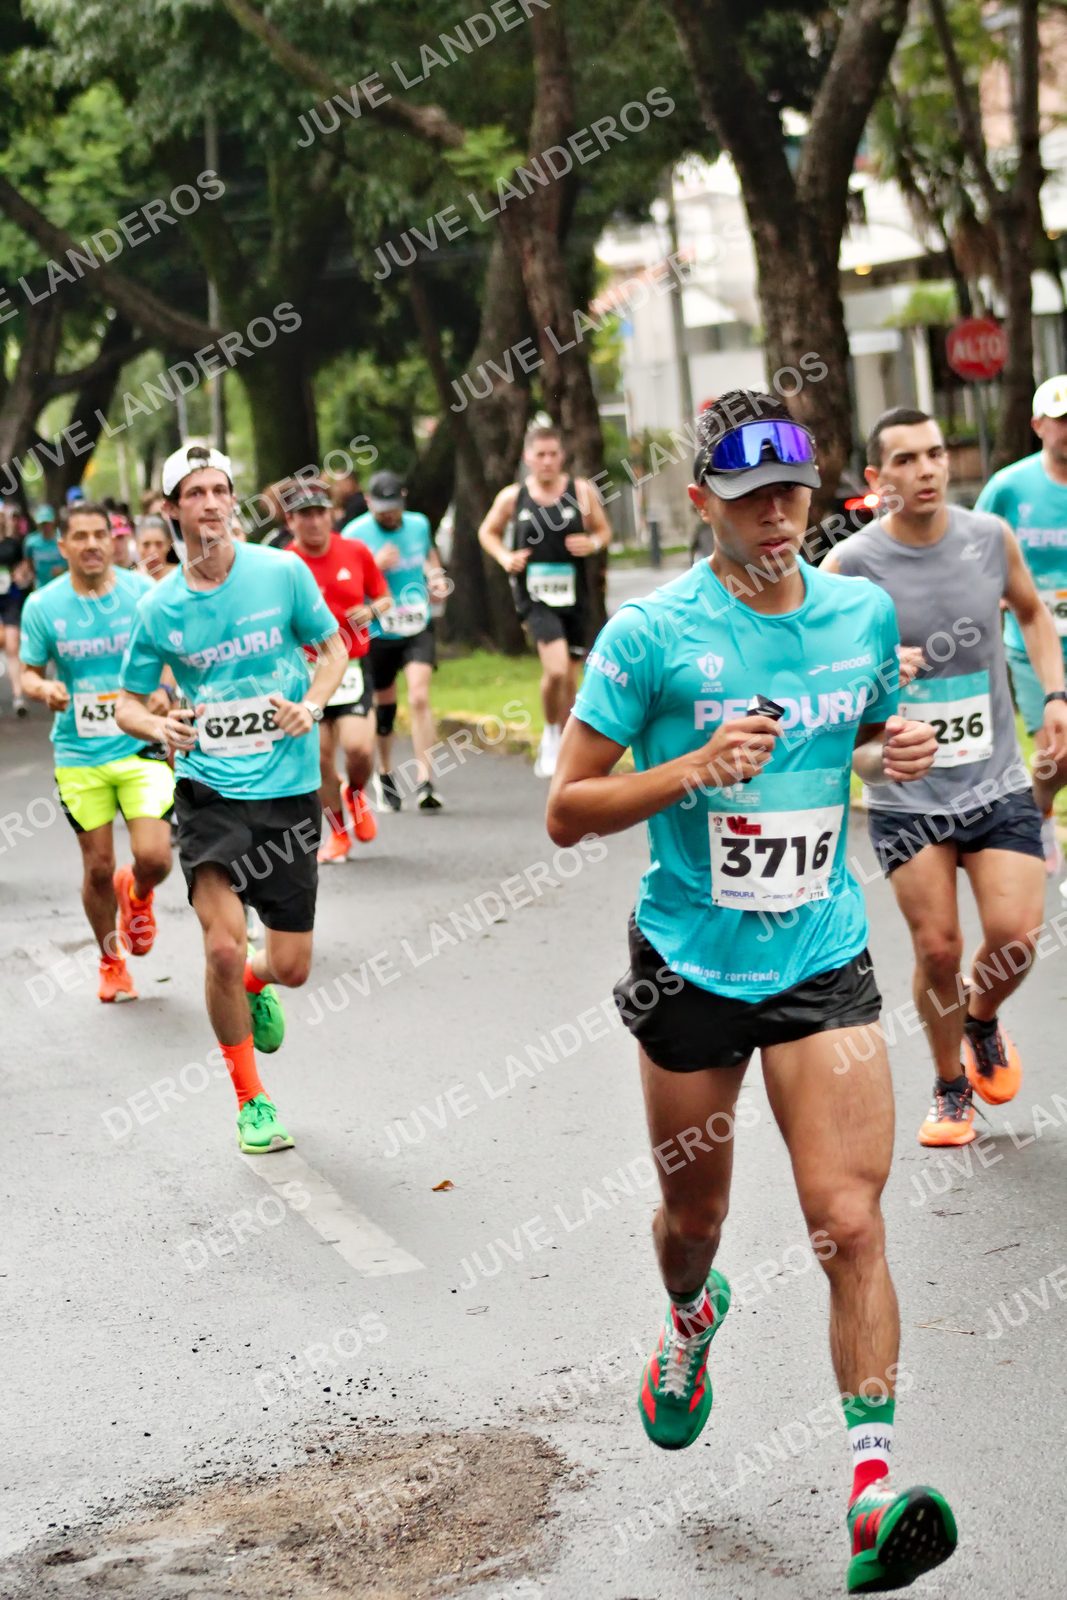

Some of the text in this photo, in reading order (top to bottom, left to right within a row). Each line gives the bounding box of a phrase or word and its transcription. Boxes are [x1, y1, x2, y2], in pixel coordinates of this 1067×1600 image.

[952, 335, 1000, 362] ALTO
[694, 686, 868, 731] PEDURA
[205, 709, 281, 739] 6228
[920, 712, 984, 745] 236
[720, 831, 833, 878] 3716
[720, 889, 755, 899] PERDURA
[724, 968, 780, 983] corriendo
